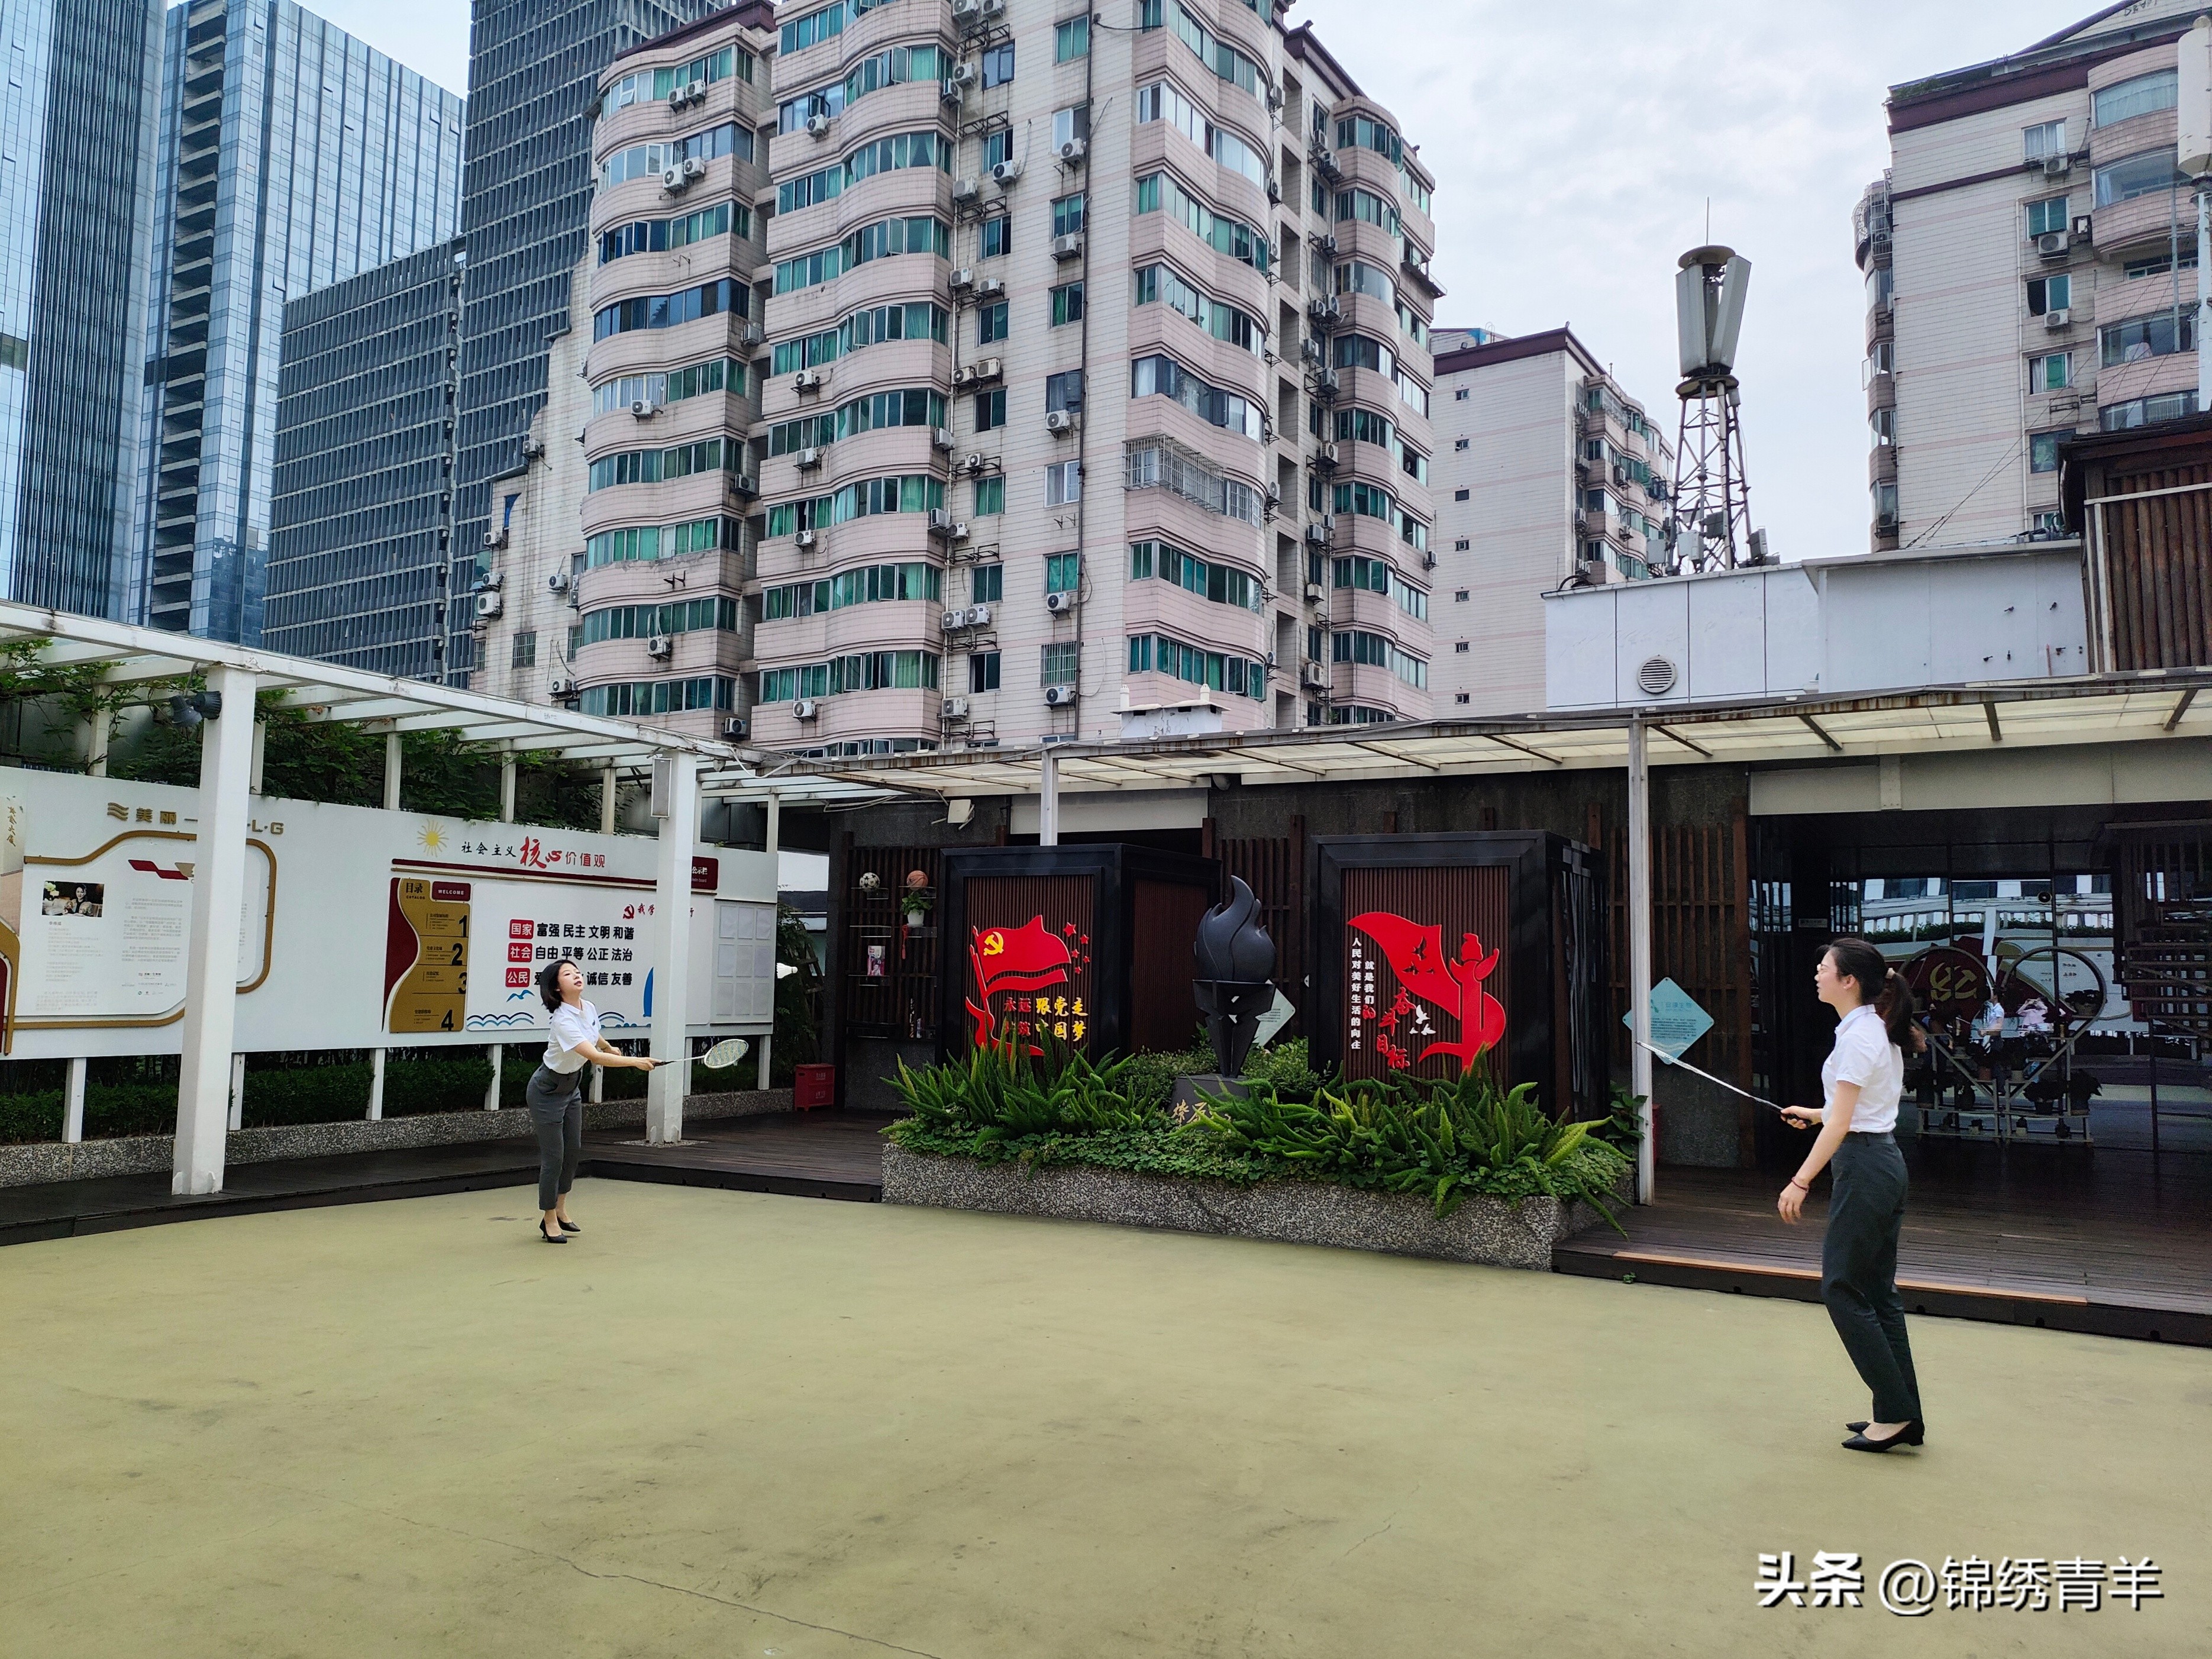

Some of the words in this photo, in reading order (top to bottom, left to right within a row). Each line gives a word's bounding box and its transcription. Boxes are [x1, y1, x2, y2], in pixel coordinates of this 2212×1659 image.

[461, 835, 605, 869] 社会主义核心价值观
[405, 882, 423, 894] 目录
[458, 915, 467, 937] 1
[511, 923, 532, 936] 国家
[451, 943, 463, 966] 2
[510, 946, 531, 959] 社会
[457, 971, 467, 994] 3
[507, 971, 528, 984] 公民
[441, 1009, 454, 1031] 4
